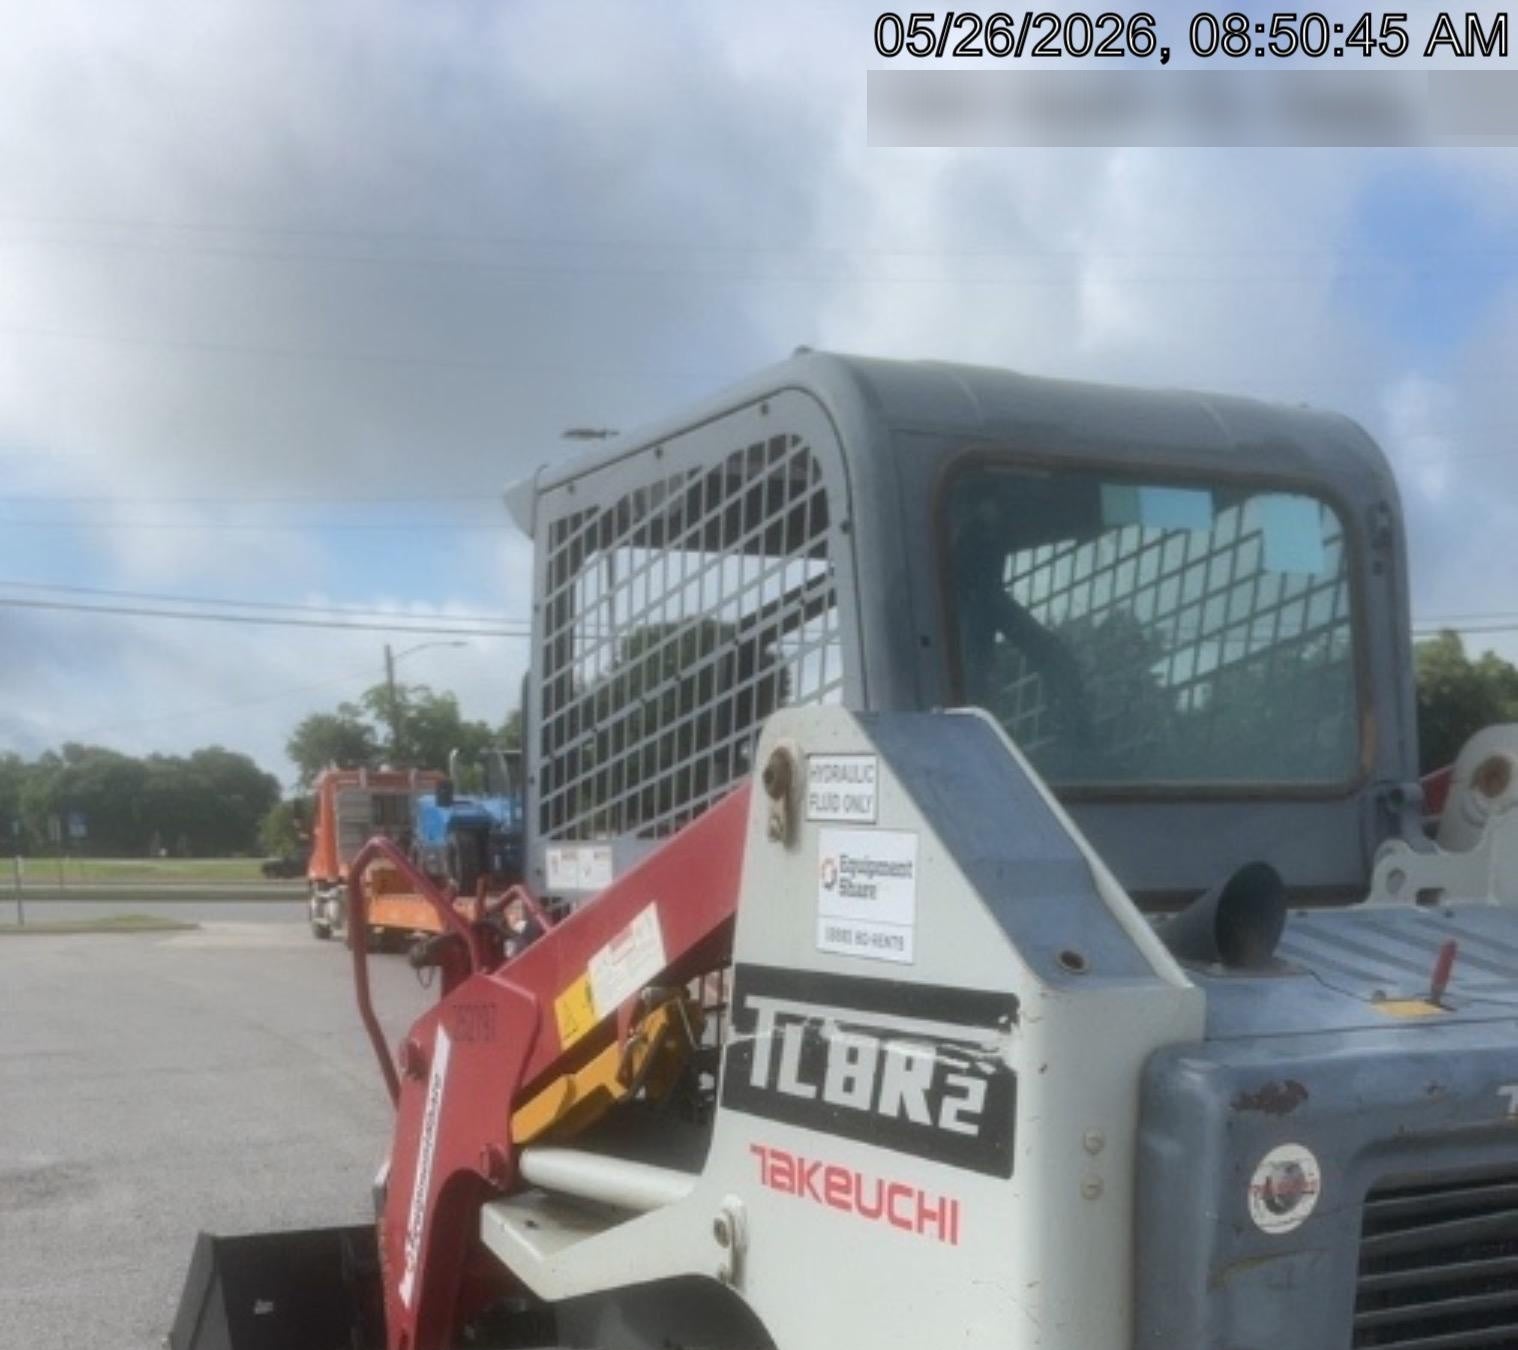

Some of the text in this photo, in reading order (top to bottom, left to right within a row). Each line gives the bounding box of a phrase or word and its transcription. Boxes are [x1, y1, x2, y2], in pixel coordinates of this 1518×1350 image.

[808, 764, 875, 785] HYDRAULIC
[843, 793, 874, 815] ONLY
[750, 1143, 959, 1246] TAKEUCHI
